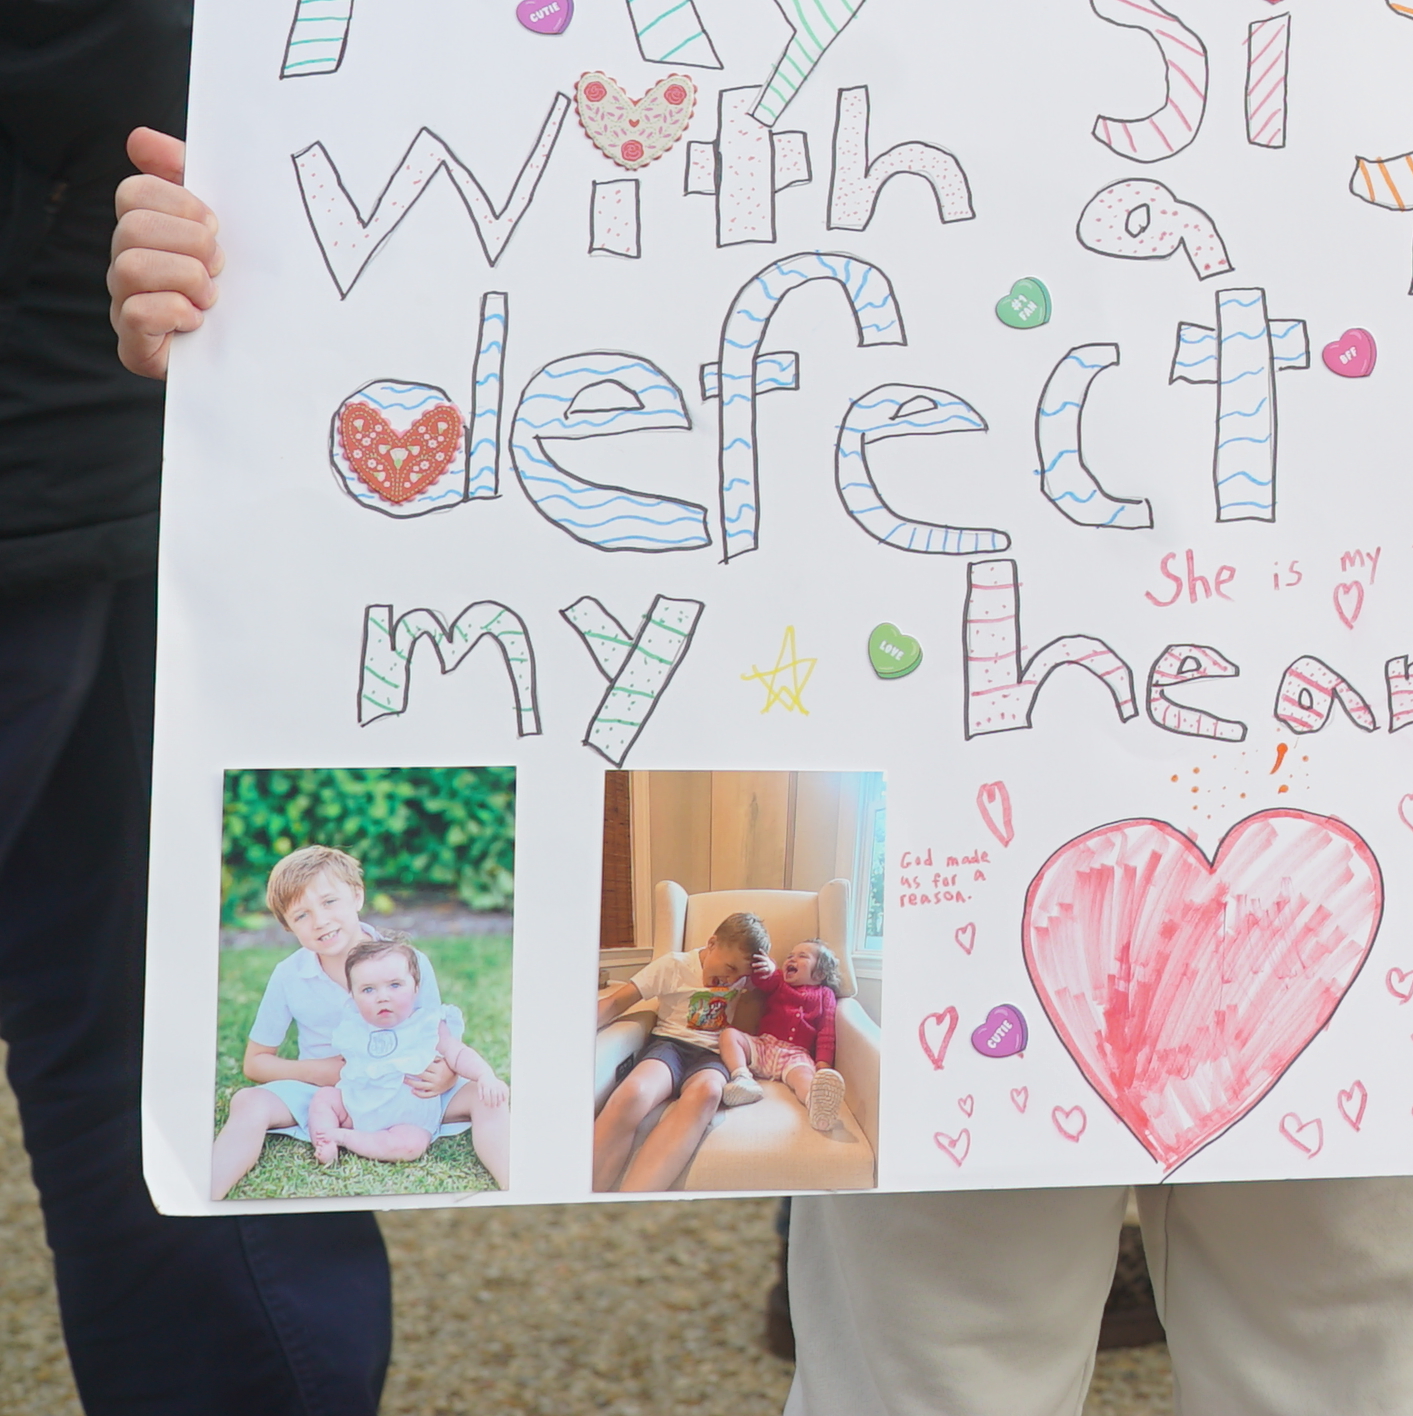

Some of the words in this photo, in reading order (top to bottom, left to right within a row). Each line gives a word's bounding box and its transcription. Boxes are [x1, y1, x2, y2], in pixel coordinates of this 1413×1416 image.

[529, 1, 561, 23] CUTIE
[1018, 300, 1038, 321] FAN
[330, 251, 1310, 564] defect
[1145, 548, 1236, 607] She
[1273, 560, 1303, 590] is
[1340, 546, 1381, 585] my
[879, 639, 905, 661] LOVE
[358, 595, 704, 767] my
[900, 848, 933, 869] God
[946, 849, 991, 868] made
[900, 875, 921, 889] us
[931, 872, 958, 889] for
[973, 869, 987, 882] a
[899, 890, 972, 908] reason.
[987, 1019, 1013, 1049] CUTIE
